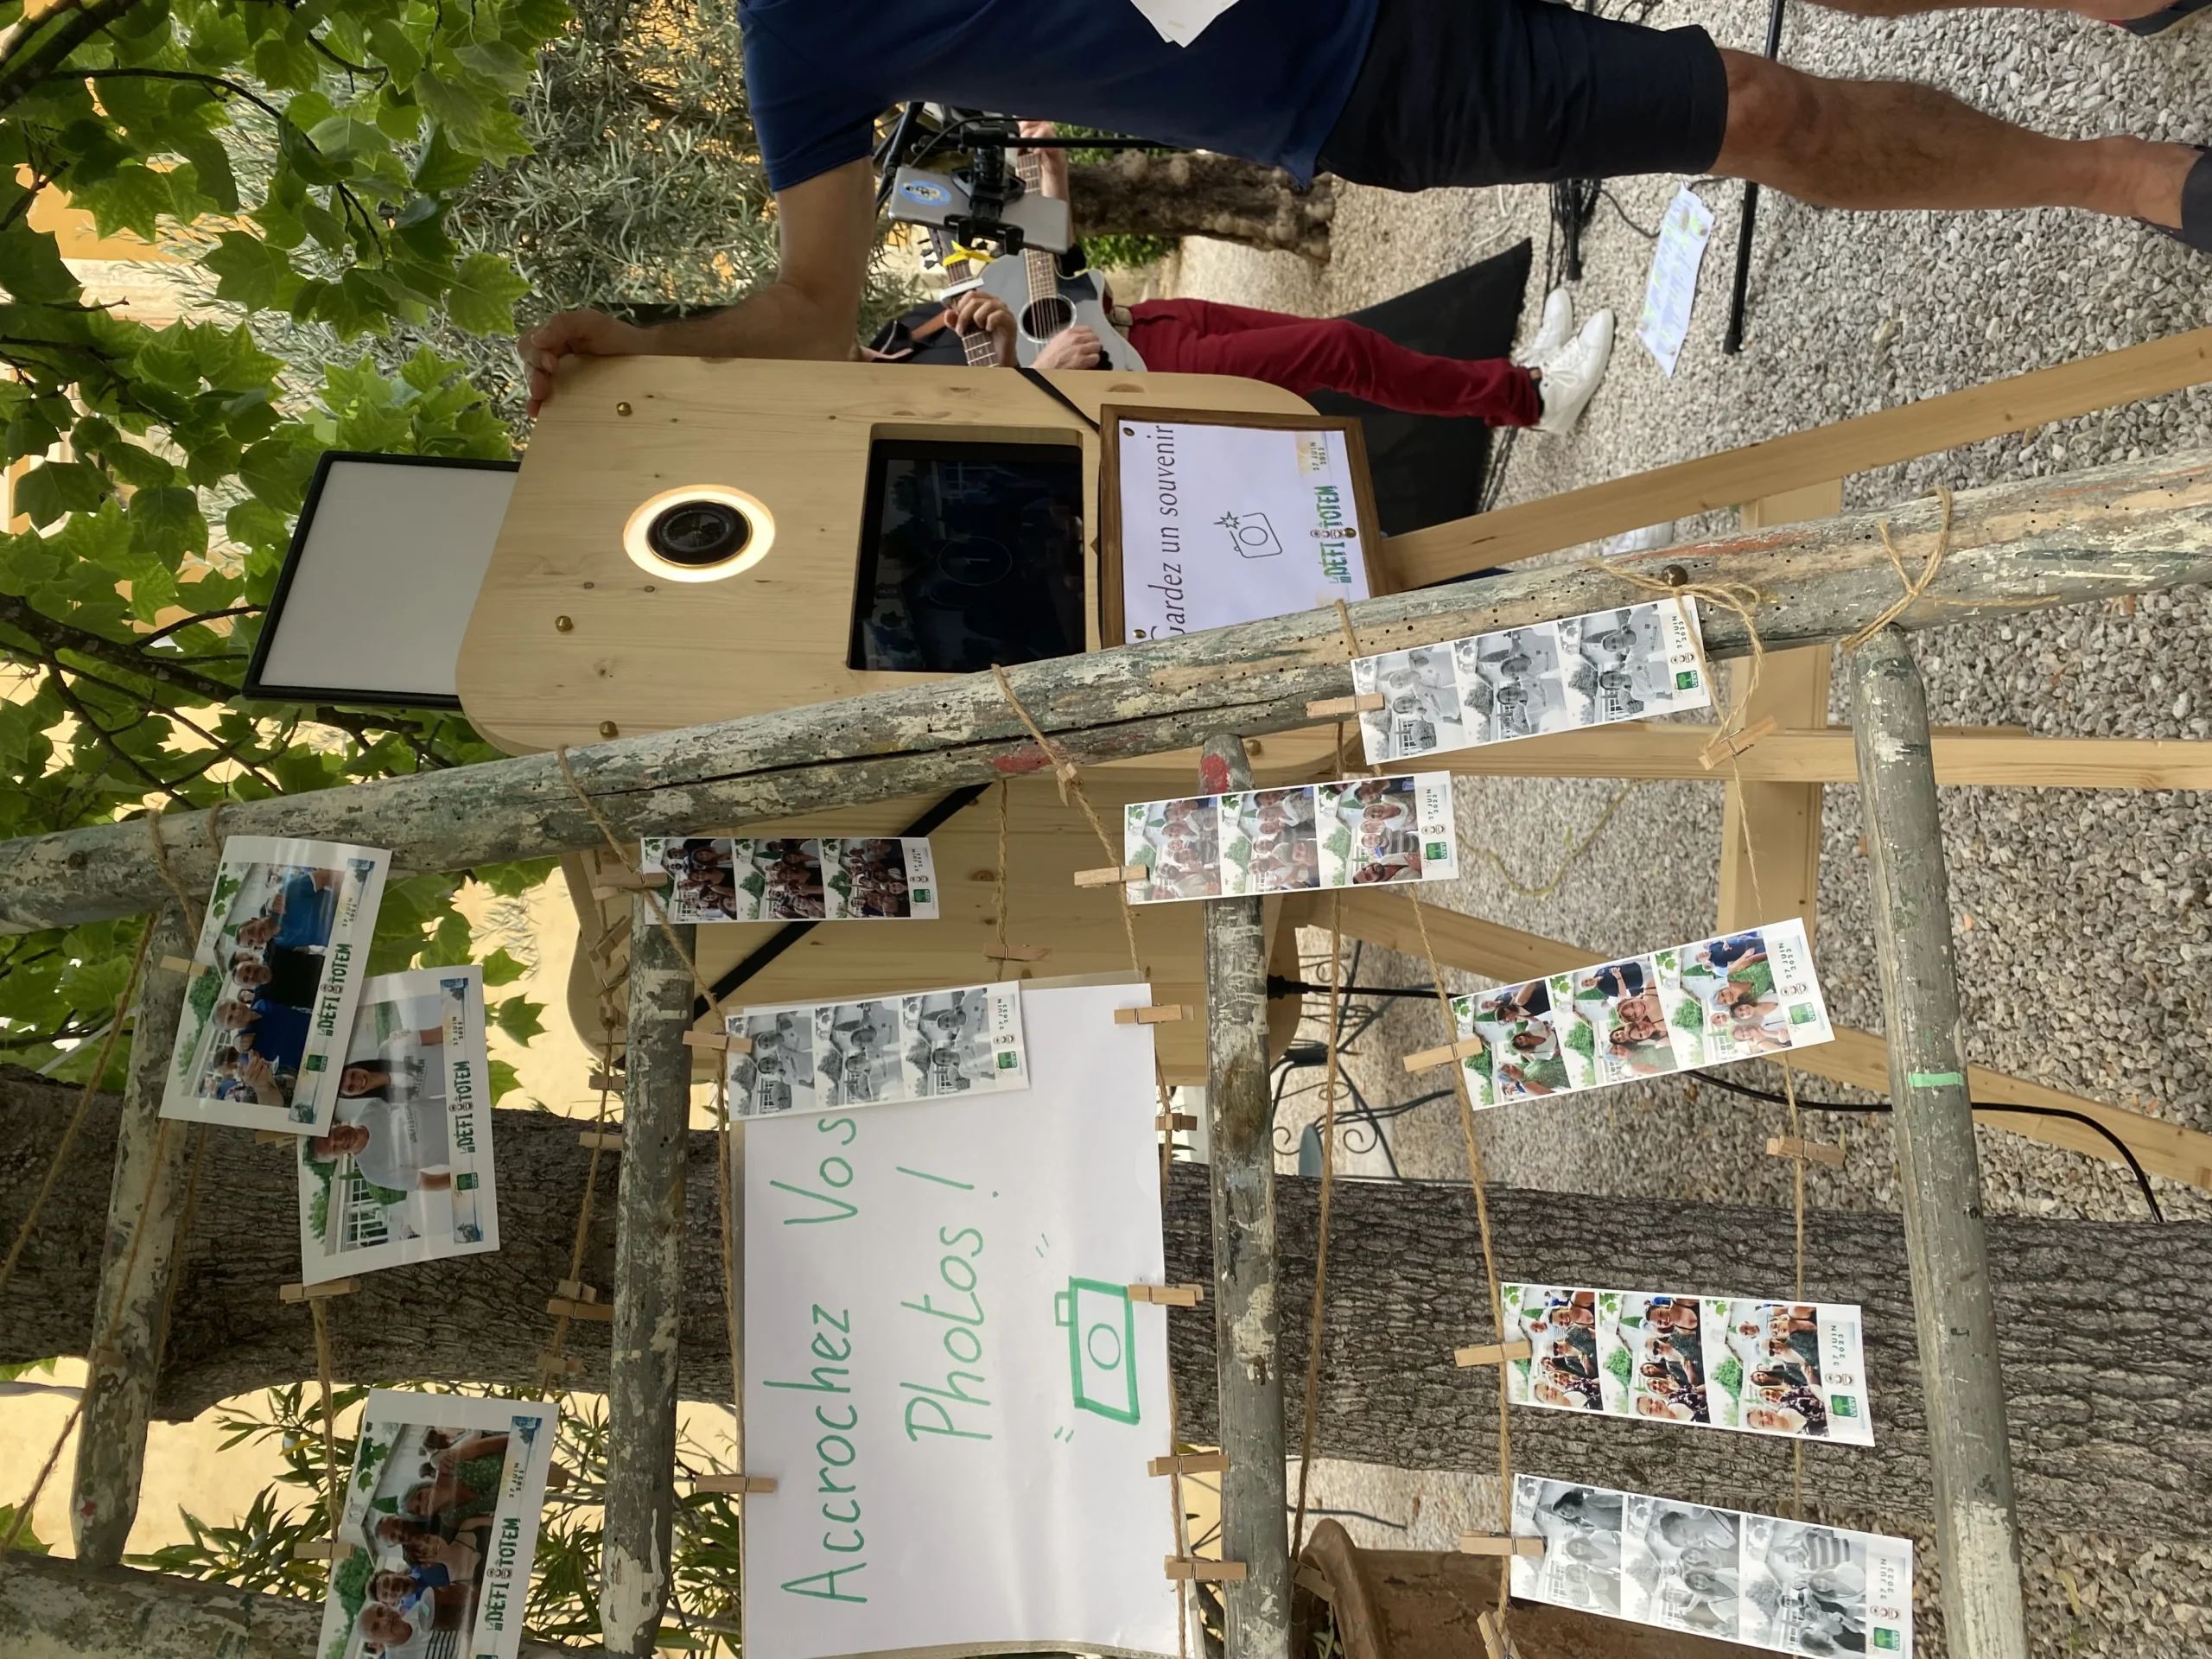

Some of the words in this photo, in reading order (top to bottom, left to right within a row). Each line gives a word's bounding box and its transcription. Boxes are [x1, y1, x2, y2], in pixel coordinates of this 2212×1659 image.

[1147, 424, 1179, 517] souvenir
[1311, 462, 1320, 472] 27
[1313, 485, 1343, 529] TOTEM
[1160, 526, 1180, 553] un
[1675, 639, 1682, 649] 27
[1427, 811, 1433, 820] 27
[330, 944, 353, 984] TOTEM
[1778, 943, 1788, 963] JUIN
[1786, 948, 1796, 970] 2023
[1784, 969, 1792, 979] 27
[999, 1021, 1004, 1031] 27
[453, 1060, 473, 1103] TOTEM
[770, 1116, 859, 1225] Vos
[899, 1225, 993, 1441] Photos
[1833, 1355, 1839, 1365] 27
[763, 1302, 868, 1604] Accrochez
[508, 1488, 515, 1498] 27
[498, 1518, 521, 1567] TOTEM
[1880, 1588, 1886, 1599] 27
